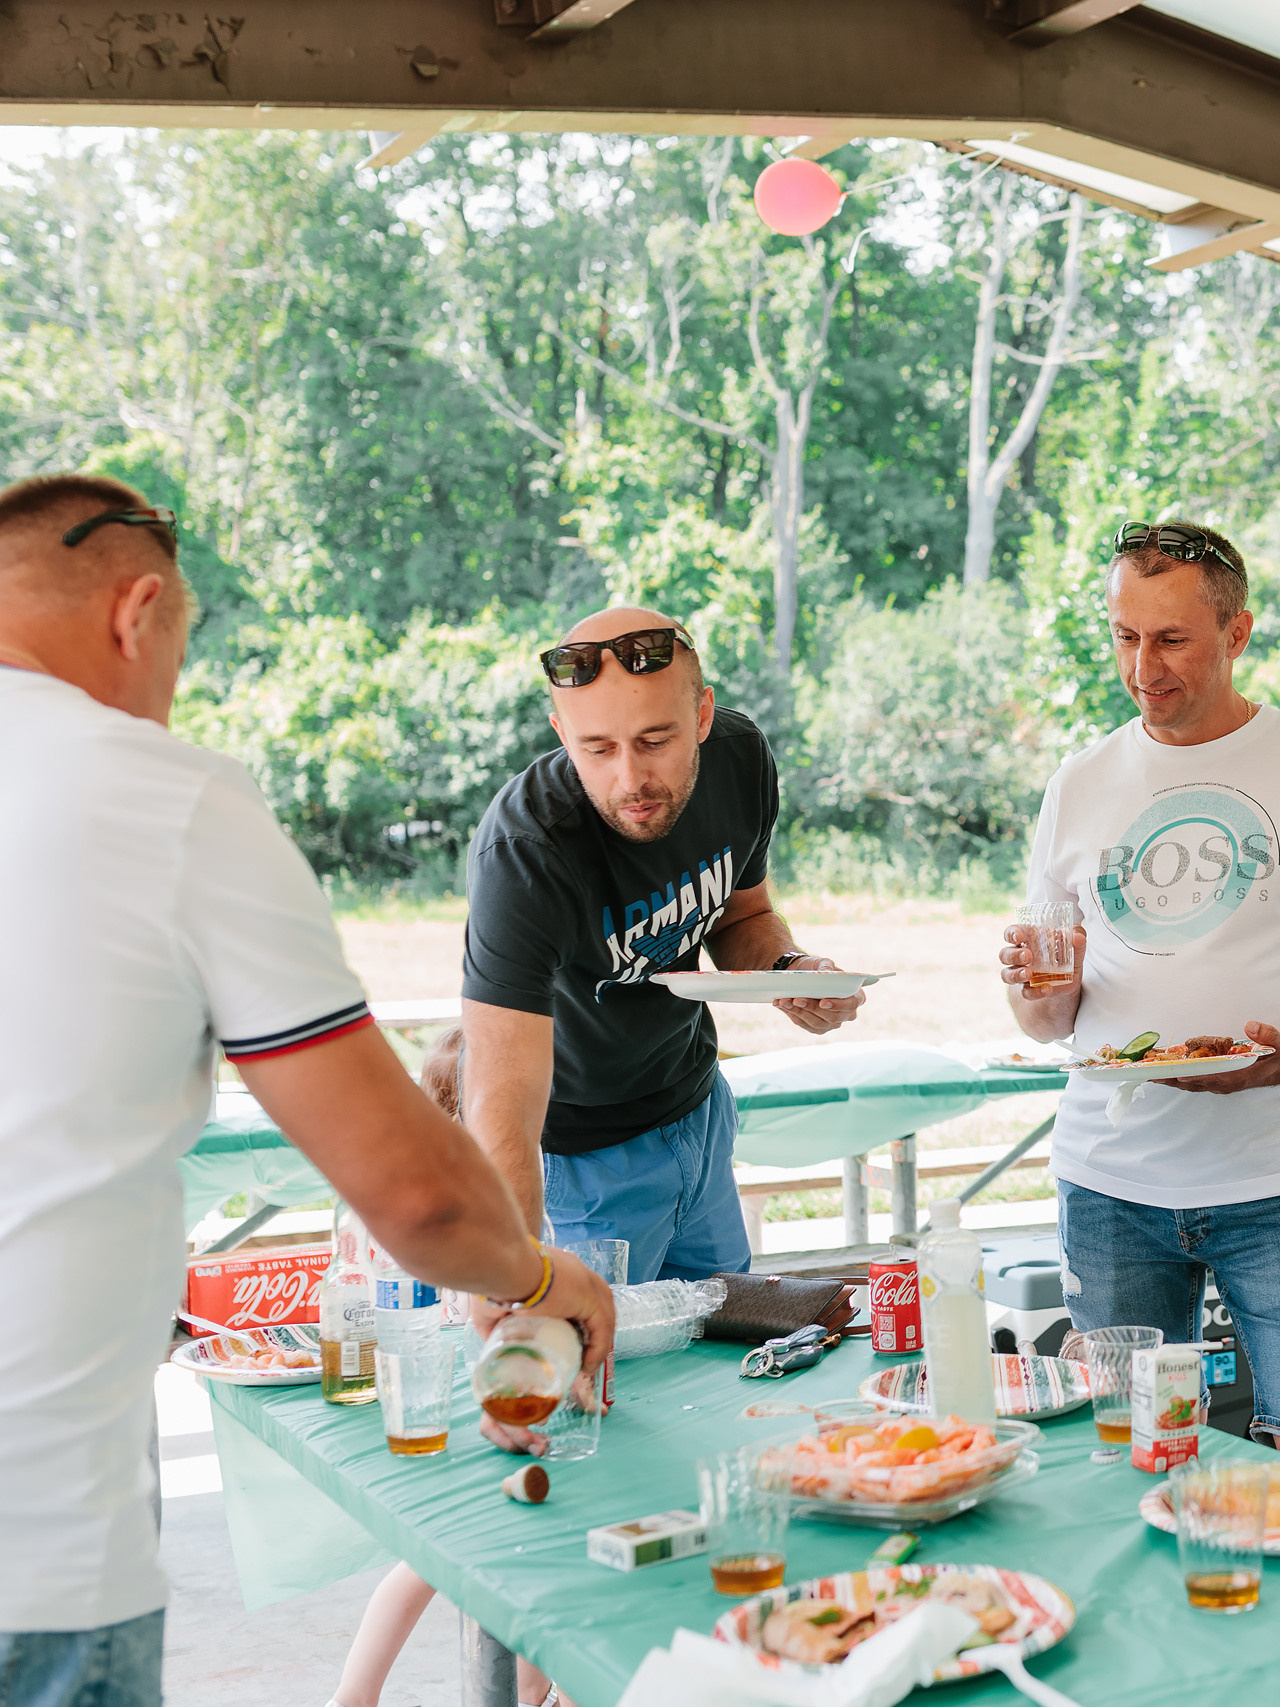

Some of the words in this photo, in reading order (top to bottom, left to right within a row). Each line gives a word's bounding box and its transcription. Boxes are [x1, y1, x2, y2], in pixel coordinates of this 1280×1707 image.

[1095, 832, 1275, 893] BOSS
[1192, 887, 1269, 904] BOSS
[603, 845, 733, 973] ARMANI
[258, 1260, 293, 1272] TASTE
[295, 1255, 332, 1267] GINAL
[343, 1308, 376, 1322] Coro
[1157, 1361, 1198, 1374] Honest
